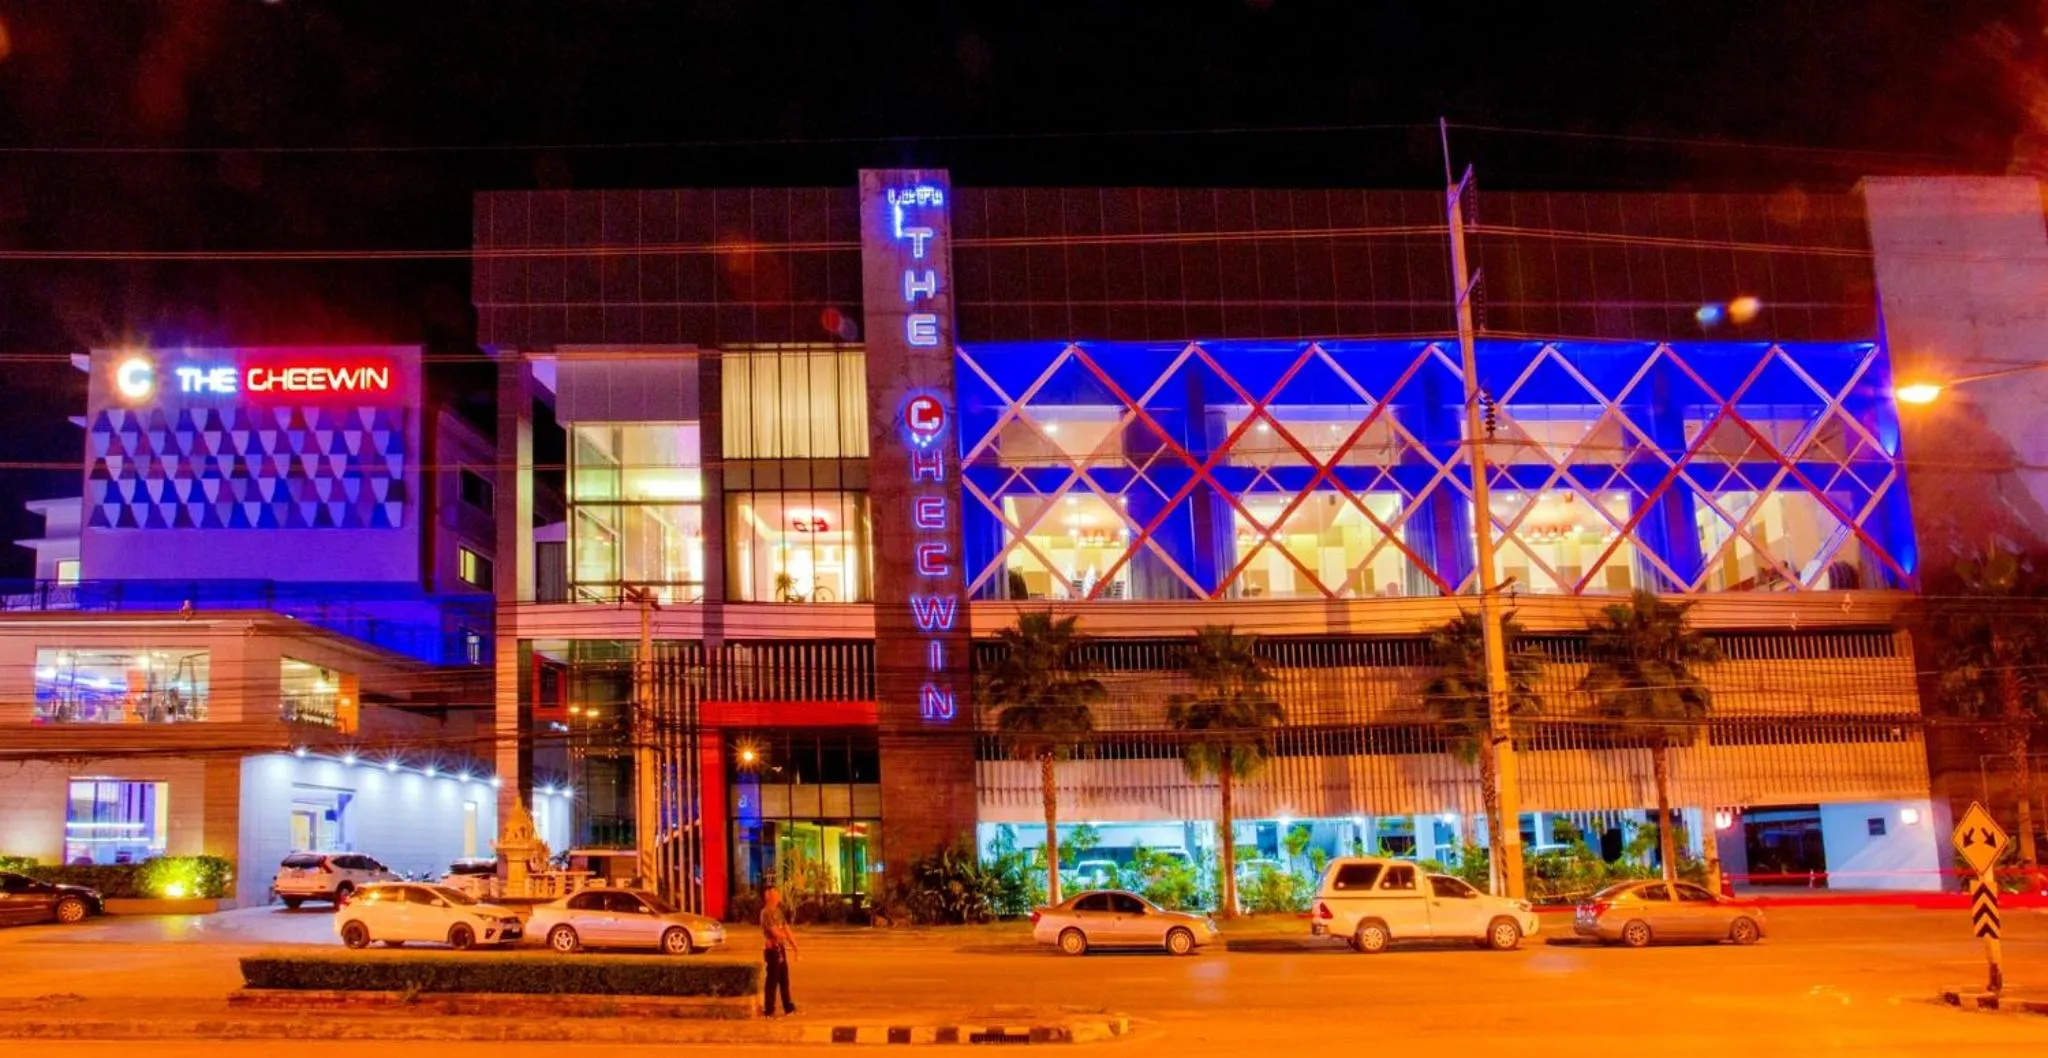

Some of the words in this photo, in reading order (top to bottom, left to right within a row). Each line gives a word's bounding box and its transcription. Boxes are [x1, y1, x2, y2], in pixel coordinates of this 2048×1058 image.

[904, 227, 937, 346] THE
[176, 366, 237, 393] THE
[247, 366, 388, 391] CHEEWIN
